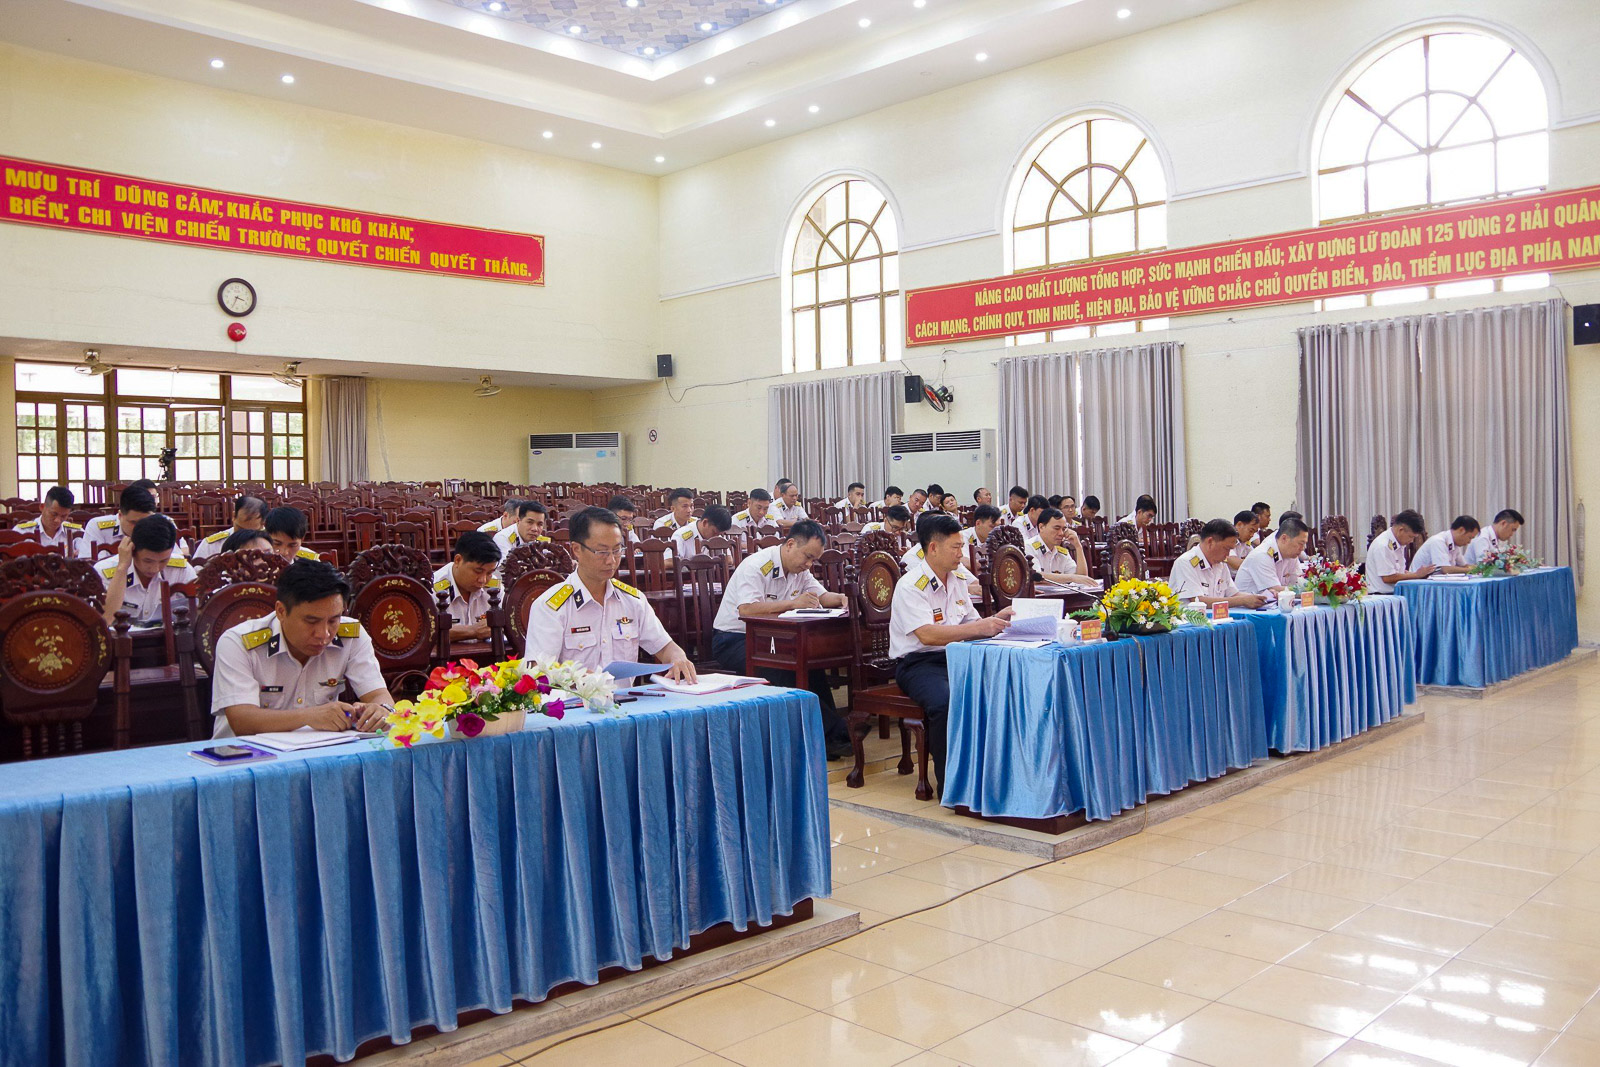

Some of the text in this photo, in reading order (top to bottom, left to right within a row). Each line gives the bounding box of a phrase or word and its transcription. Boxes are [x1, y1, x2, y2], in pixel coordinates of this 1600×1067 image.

[6, 168, 58, 192] MƯU
[66, 178, 100, 198] TRÍ
[114, 184, 169, 208] DŨNG
[227, 200, 274, 222] KHẮC
[280, 210, 324, 230] PHỤC
[330, 216, 362, 234] KHÓ
[368, 222, 414, 244] KHĂN;
[10, 194, 532, 277] BIỂN; CHI VIỆN CHIẾN TRƯỜNG; QUYẾT CHIẾN QUYẾT THẮNG.
[916, 320, 938, 338] CÁCH
[941, 318, 970, 338] MẠNG,
[973, 312, 1002, 332] CHÍNH
[1004, 311, 1025, 330] QUY,
[1027, 307, 1050, 325] TINH
[1052, 300, 1084, 322] NHUỆ,
[1086, 297, 1112, 320] HIỆN
[1114, 296, 1136, 316] ĐẠI,
[1140, 288, 1162, 312] BẢO
[1165, 287, 1180, 310] VỆ
[1182, 284, 1214, 306] VỮNG
[1218, 276, 1252, 302] CHẮC
[1254, 272, 1280, 297] CHỦ
[1284, 266, 1328, 295] QUYỀN
[1332, 260, 1368, 288] BIỂN,
[1372, 257, 1406, 282] ĐẢO,
[1410, 250, 1452, 278] THỀM
[1456, 250, 1486, 275] LỤC
[1490, 246, 1518, 271] ĐỊA
[1522, 237, 1562, 264] PHÍA
[975, 198, 1600, 306] NÂNG CAO CHẤT LƯỢNG TỔNG HỢP, SỨC MẠNH CHIẾN ĐẤU; XÂY DỰNG LỮ ĐOÀN 125 VÙNG 2 HẢI QUÂN
[770, 636, 776, 655] A
